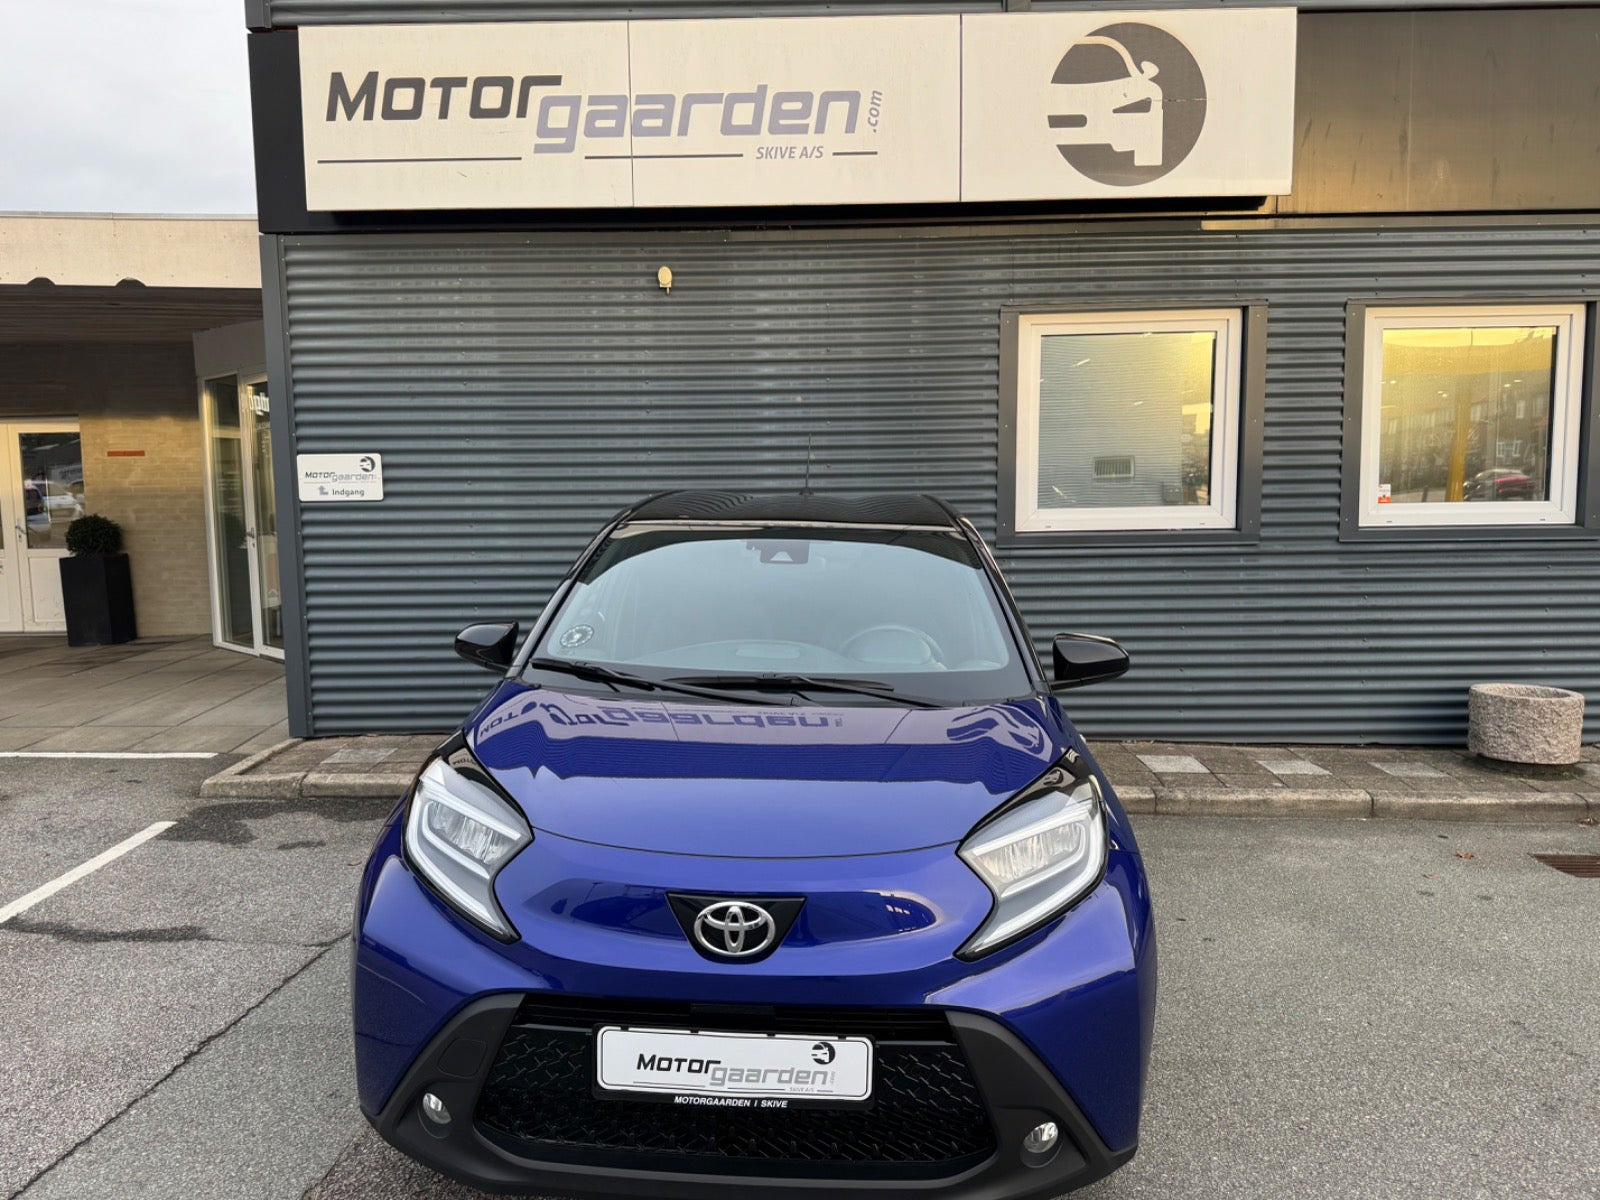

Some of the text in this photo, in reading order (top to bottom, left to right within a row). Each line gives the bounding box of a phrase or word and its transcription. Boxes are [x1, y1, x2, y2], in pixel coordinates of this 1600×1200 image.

[867, 90, 883, 133] .com
[756, 145, 824, 160] SKIVE A/S
[332, 488, 364, 497] Indgang
[674, 1096, 750, 1107] MOTORGAARDEN
[760, 1099, 788, 1107] SKIVE
